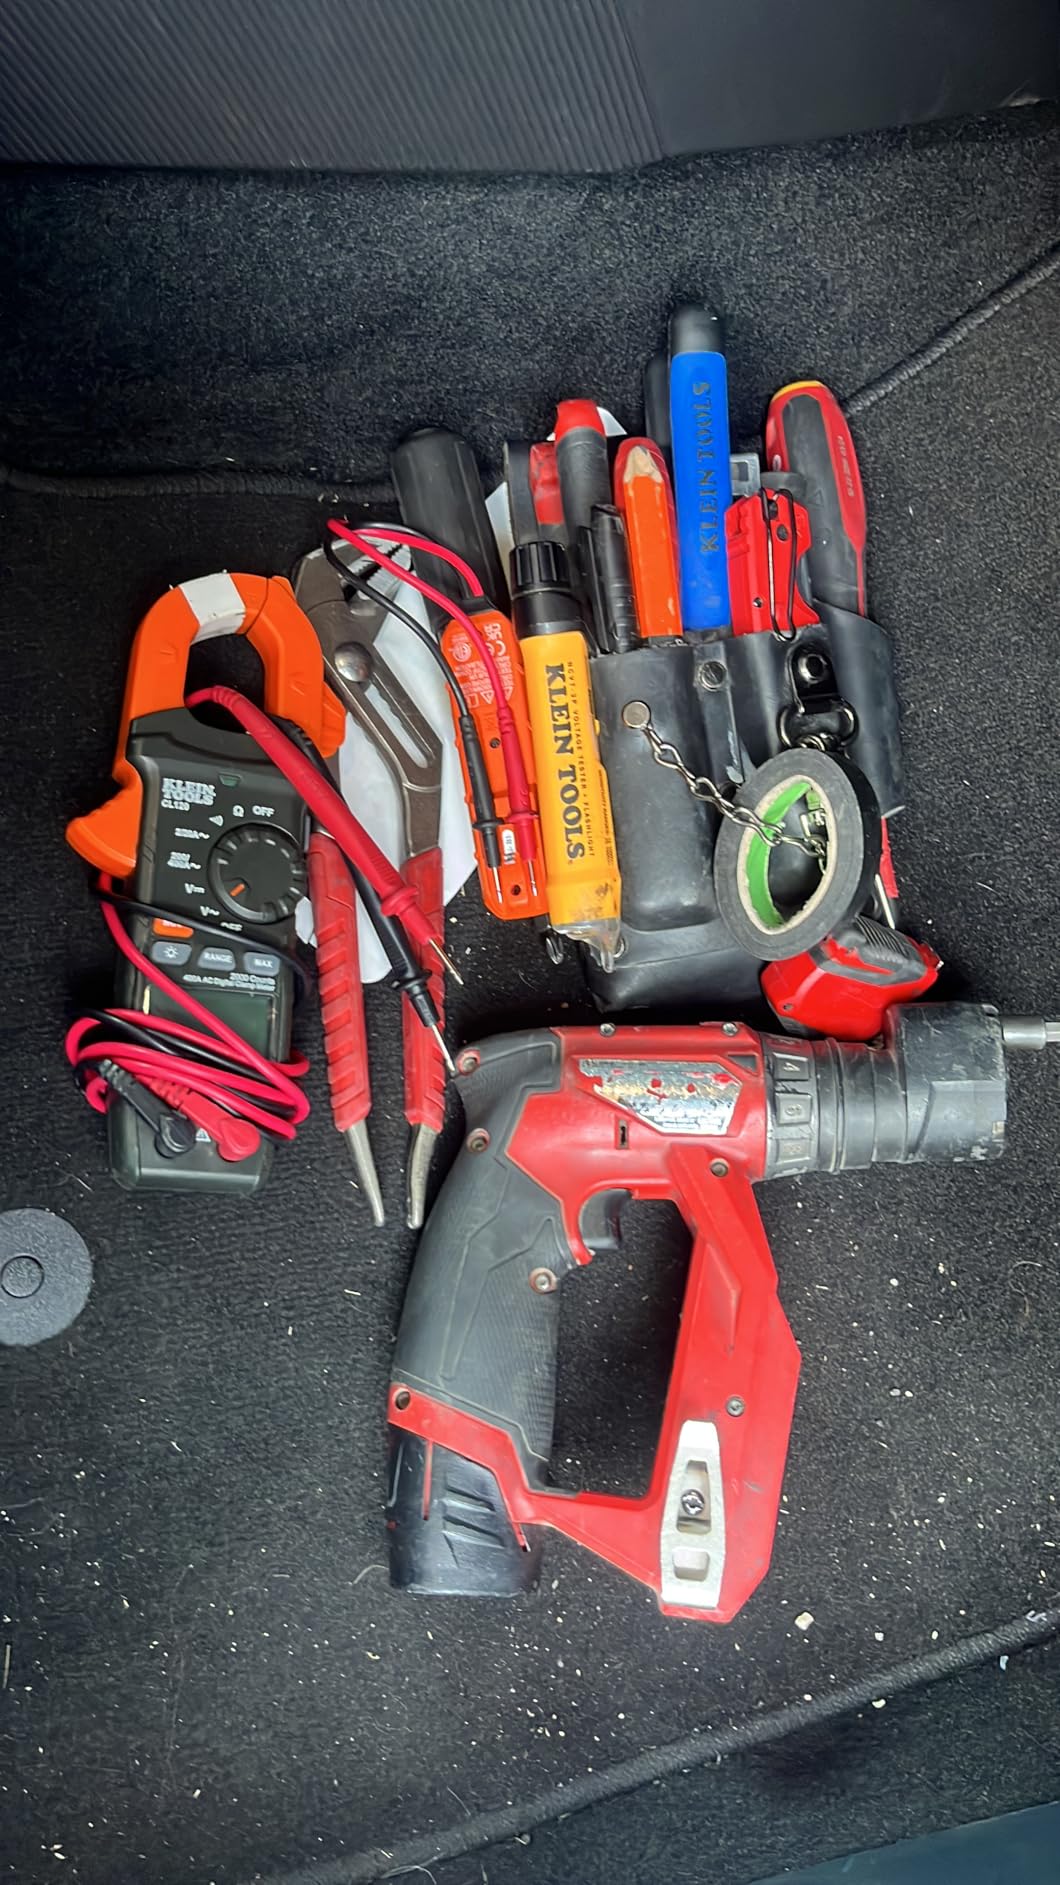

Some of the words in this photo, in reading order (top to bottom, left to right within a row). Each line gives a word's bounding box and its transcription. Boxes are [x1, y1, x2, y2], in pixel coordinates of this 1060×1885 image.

[693, 382, 714, 462] TOOLS
[698, 469, 719, 552] KLEIN
[545, 663, 575, 755] KLEIN
[162, 778, 217, 797] KLEIN
[162, 789, 215, 806] TOOLS
[573, 711, 583, 750] VOLTAGE
[578, 756, 588, 789] TESTER
[583, 802, 595, 856] FLASHLIGHT
[252, 805, 275, 817] OFF
[558, 764, 585, 860] TOOLS
[203, 952, 232, 963] RANGE
[254, 959, 273, 969] MAX
